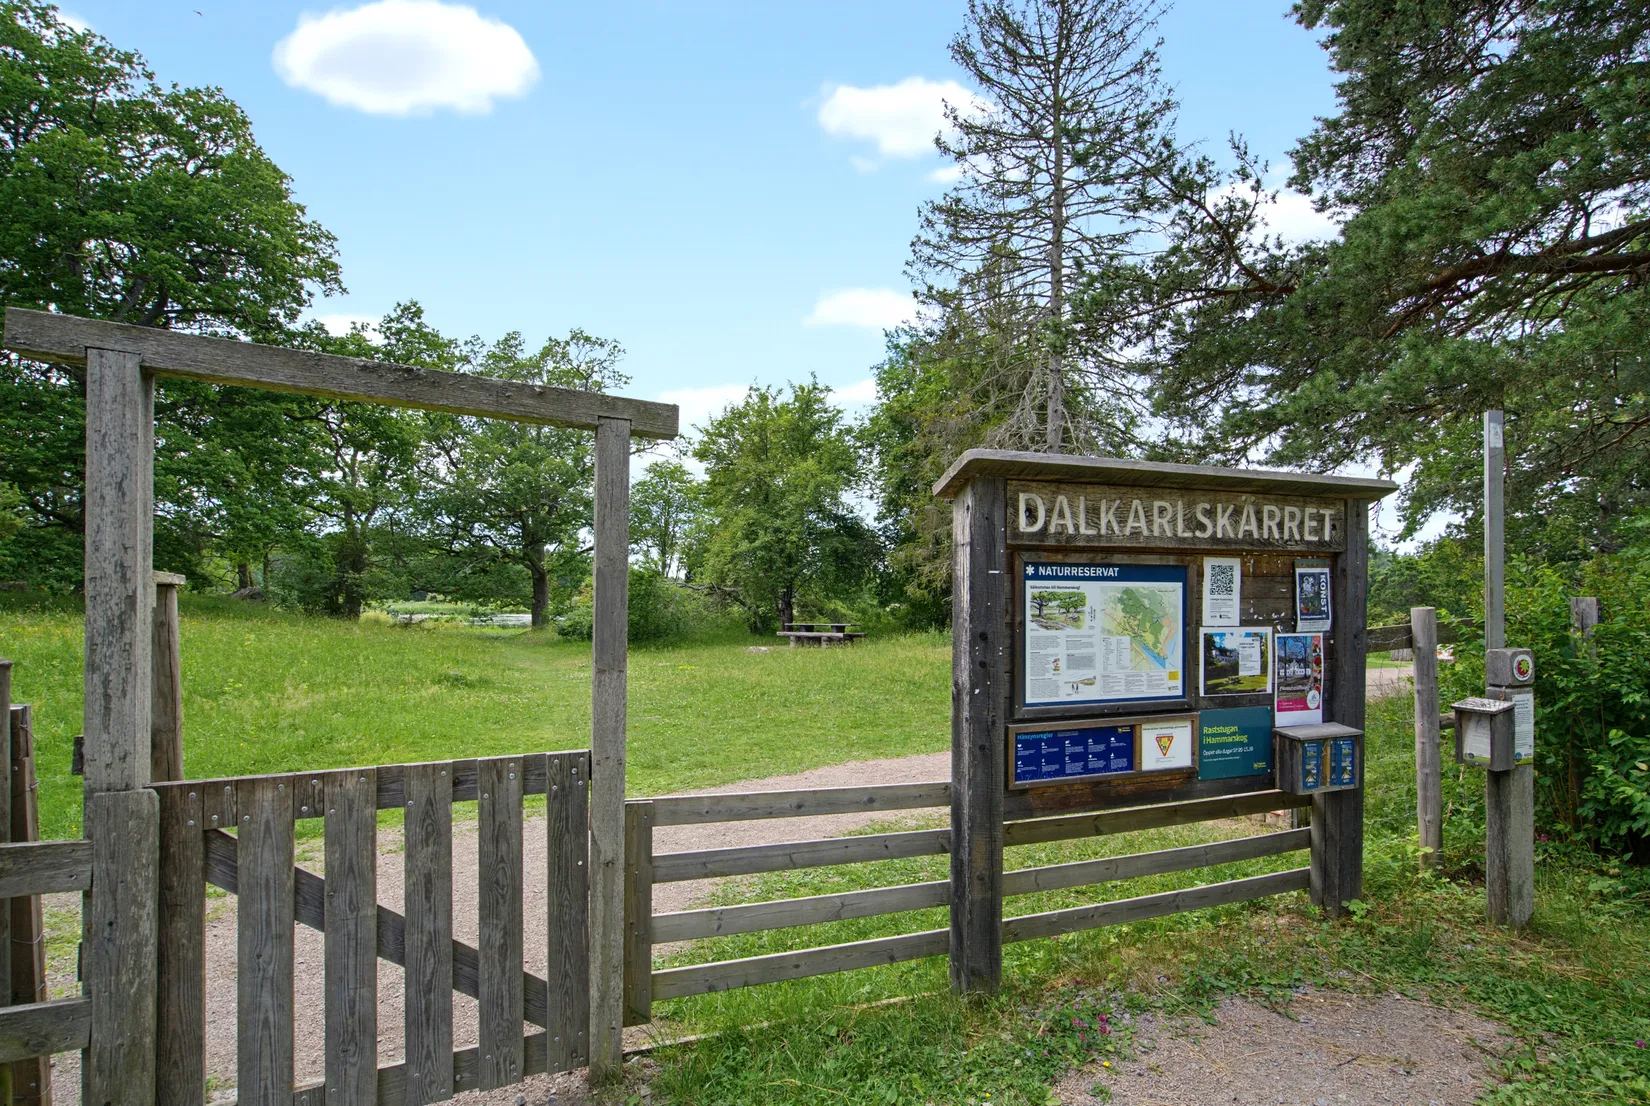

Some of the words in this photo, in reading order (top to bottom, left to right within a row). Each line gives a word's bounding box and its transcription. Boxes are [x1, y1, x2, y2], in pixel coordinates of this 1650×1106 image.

[1018, 491, 1335, 542] DALKARLSKÄRRET
[1038, 566, 1119, 577] NATURRESERVAT
[1319, 574, 1328, 613] KONST
[1203, 725, 1238, 734] Raststugan
[1206, 734, 1248, 744] Hammarskog
